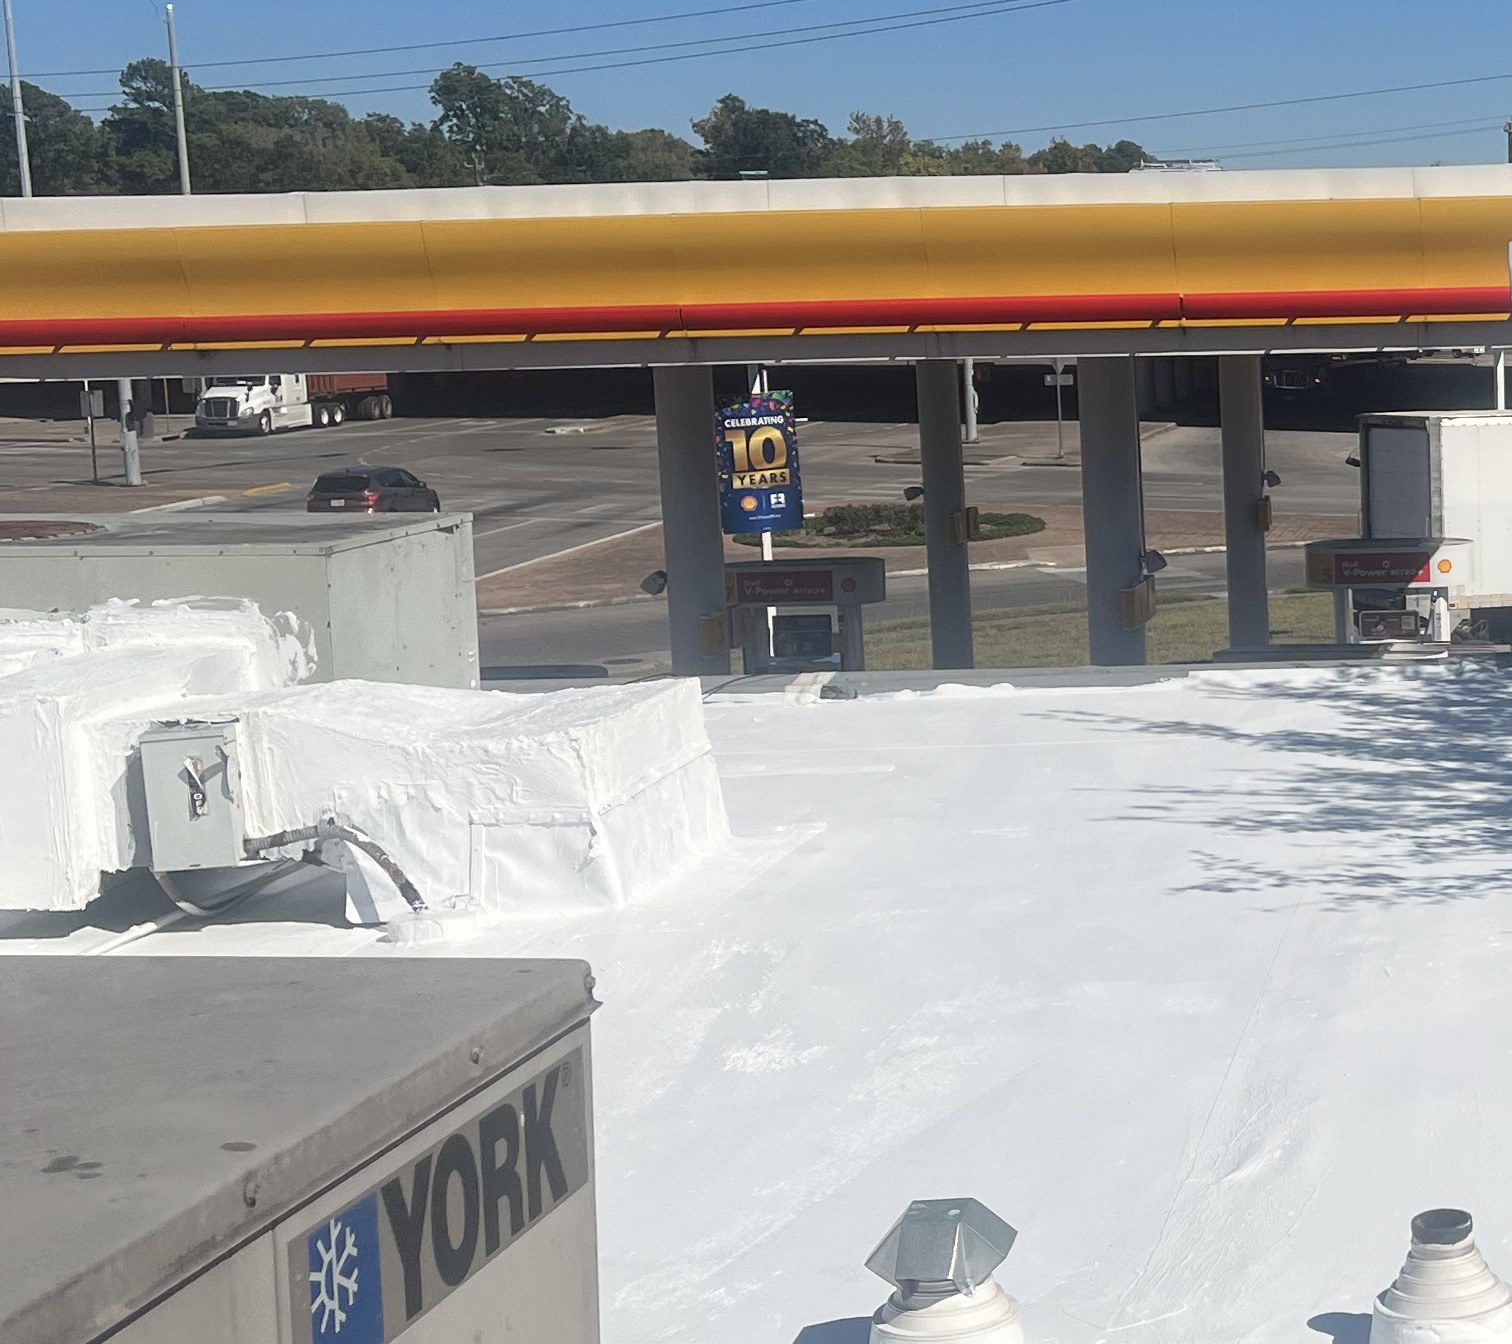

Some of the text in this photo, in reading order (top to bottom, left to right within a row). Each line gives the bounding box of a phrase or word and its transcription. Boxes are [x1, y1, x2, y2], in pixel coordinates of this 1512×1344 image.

[724, 415, 785, 428] CELEBRATING
[724, 425, 787, 472] 10
[736, 471, 787, 486] YEARS
[381, 1066, 568, 1321] YORK
